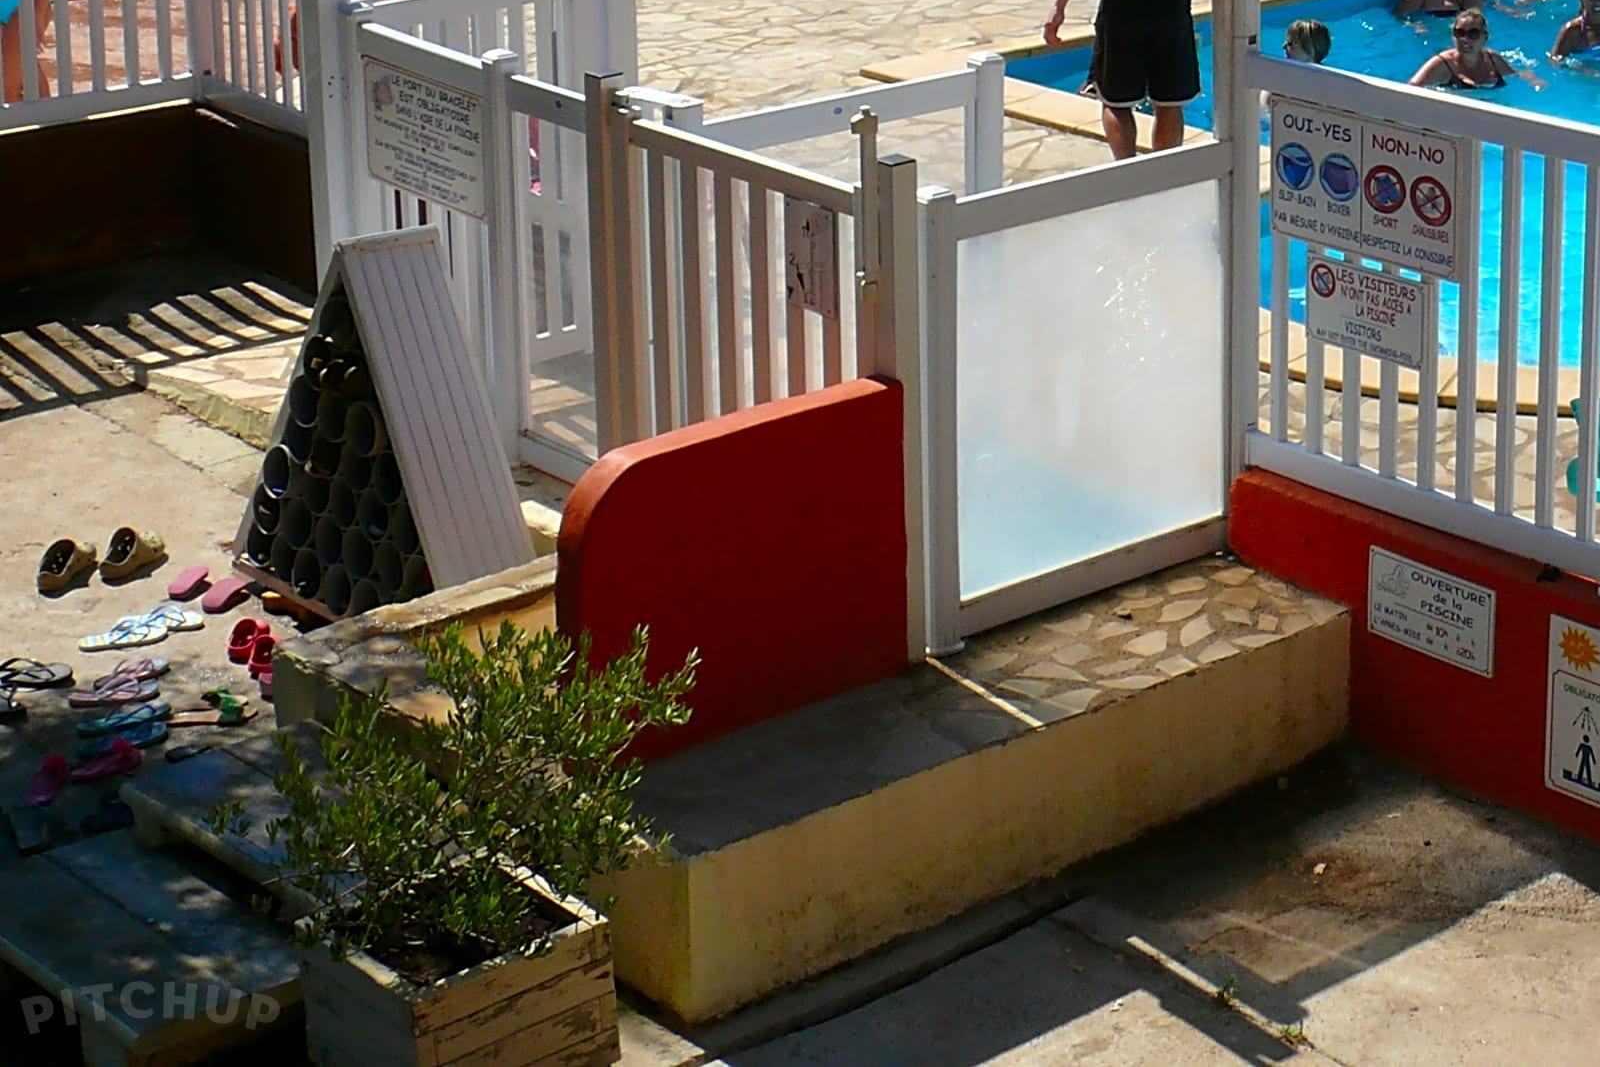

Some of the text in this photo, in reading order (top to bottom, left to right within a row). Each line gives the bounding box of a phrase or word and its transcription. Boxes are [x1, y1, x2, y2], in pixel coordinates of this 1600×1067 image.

[392, 74, 476, 113] LE PORT DU BRACELET
[400, 91, 469, 126] EST OBLIGATOIRE
[445, 123, 452, 133] LA
[455, 125, 479, 144] PISCINE
[1283, 113, 1351, 143] OUI-YES
[1373, 134, 1444, 165] NON-NO
[1279, 190, 1316, 208] SLIP-BAIN
[1328, 201, 1350, 217] BOXER
[1374, 214, 1398, 230] SHORT
[1274, 210, 1286, 222] PAR
[1290, 214, 1317, 231] MESURE
[1364, 234, 1400, 253] RESPECTEZ
[1403, 244, 1411, 256] LA
[1415, 248, 1453, 268] CONSIGNE
[1336, 268, 1416, 302] LES VISITEURS
[1341, 285, 1363, 302] N'ONT
[1366, 292, 1379, 306] PAS
[1356, 305, 1396, 327] LA PISCINE
[1345, 321, 1382, 342] VISITORS
[1411, 570, 1486, 607] OUVERTURE
[1375, 602, 1381, 611] LE
[1385, 606, 1407, 622] MATIN
[1433, 592, 1462, 611] de la
[1421, 599, 1474, 629] PISCINE
